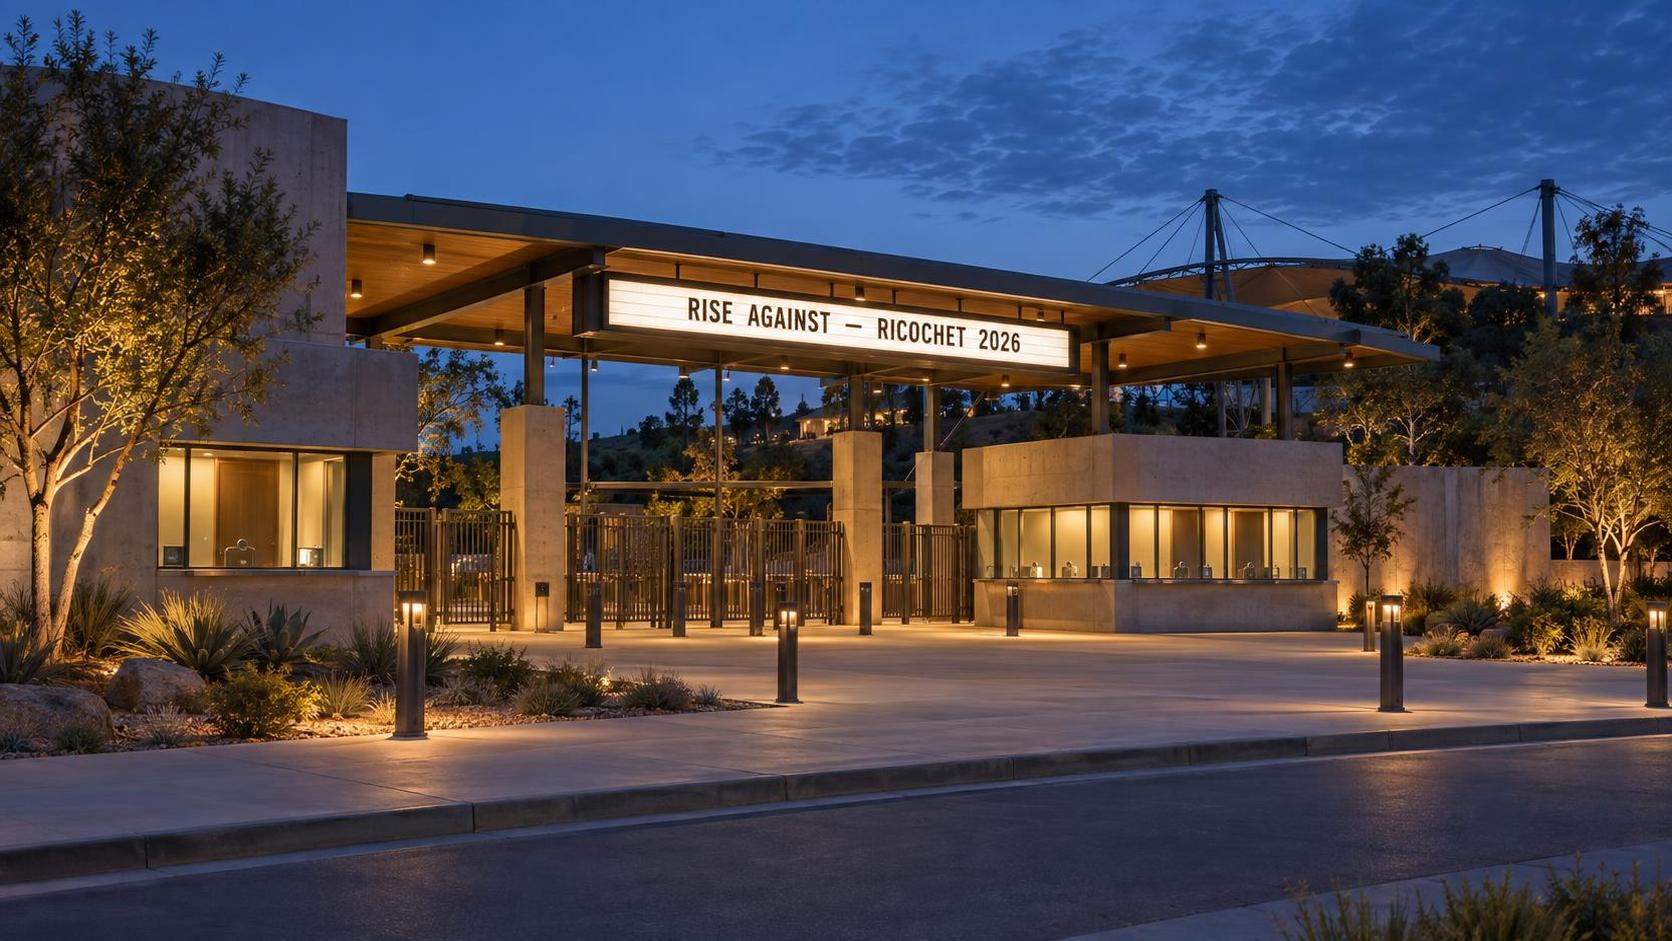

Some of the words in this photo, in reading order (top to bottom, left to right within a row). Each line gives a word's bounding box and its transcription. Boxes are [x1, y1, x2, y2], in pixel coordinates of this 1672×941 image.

[688, 297, 733, 325] RISE
[748, 303, 831, 334] AGAINST
[877, 317, 967, 348] RICOCHET
[978, 328, 1021, 353] 2026
